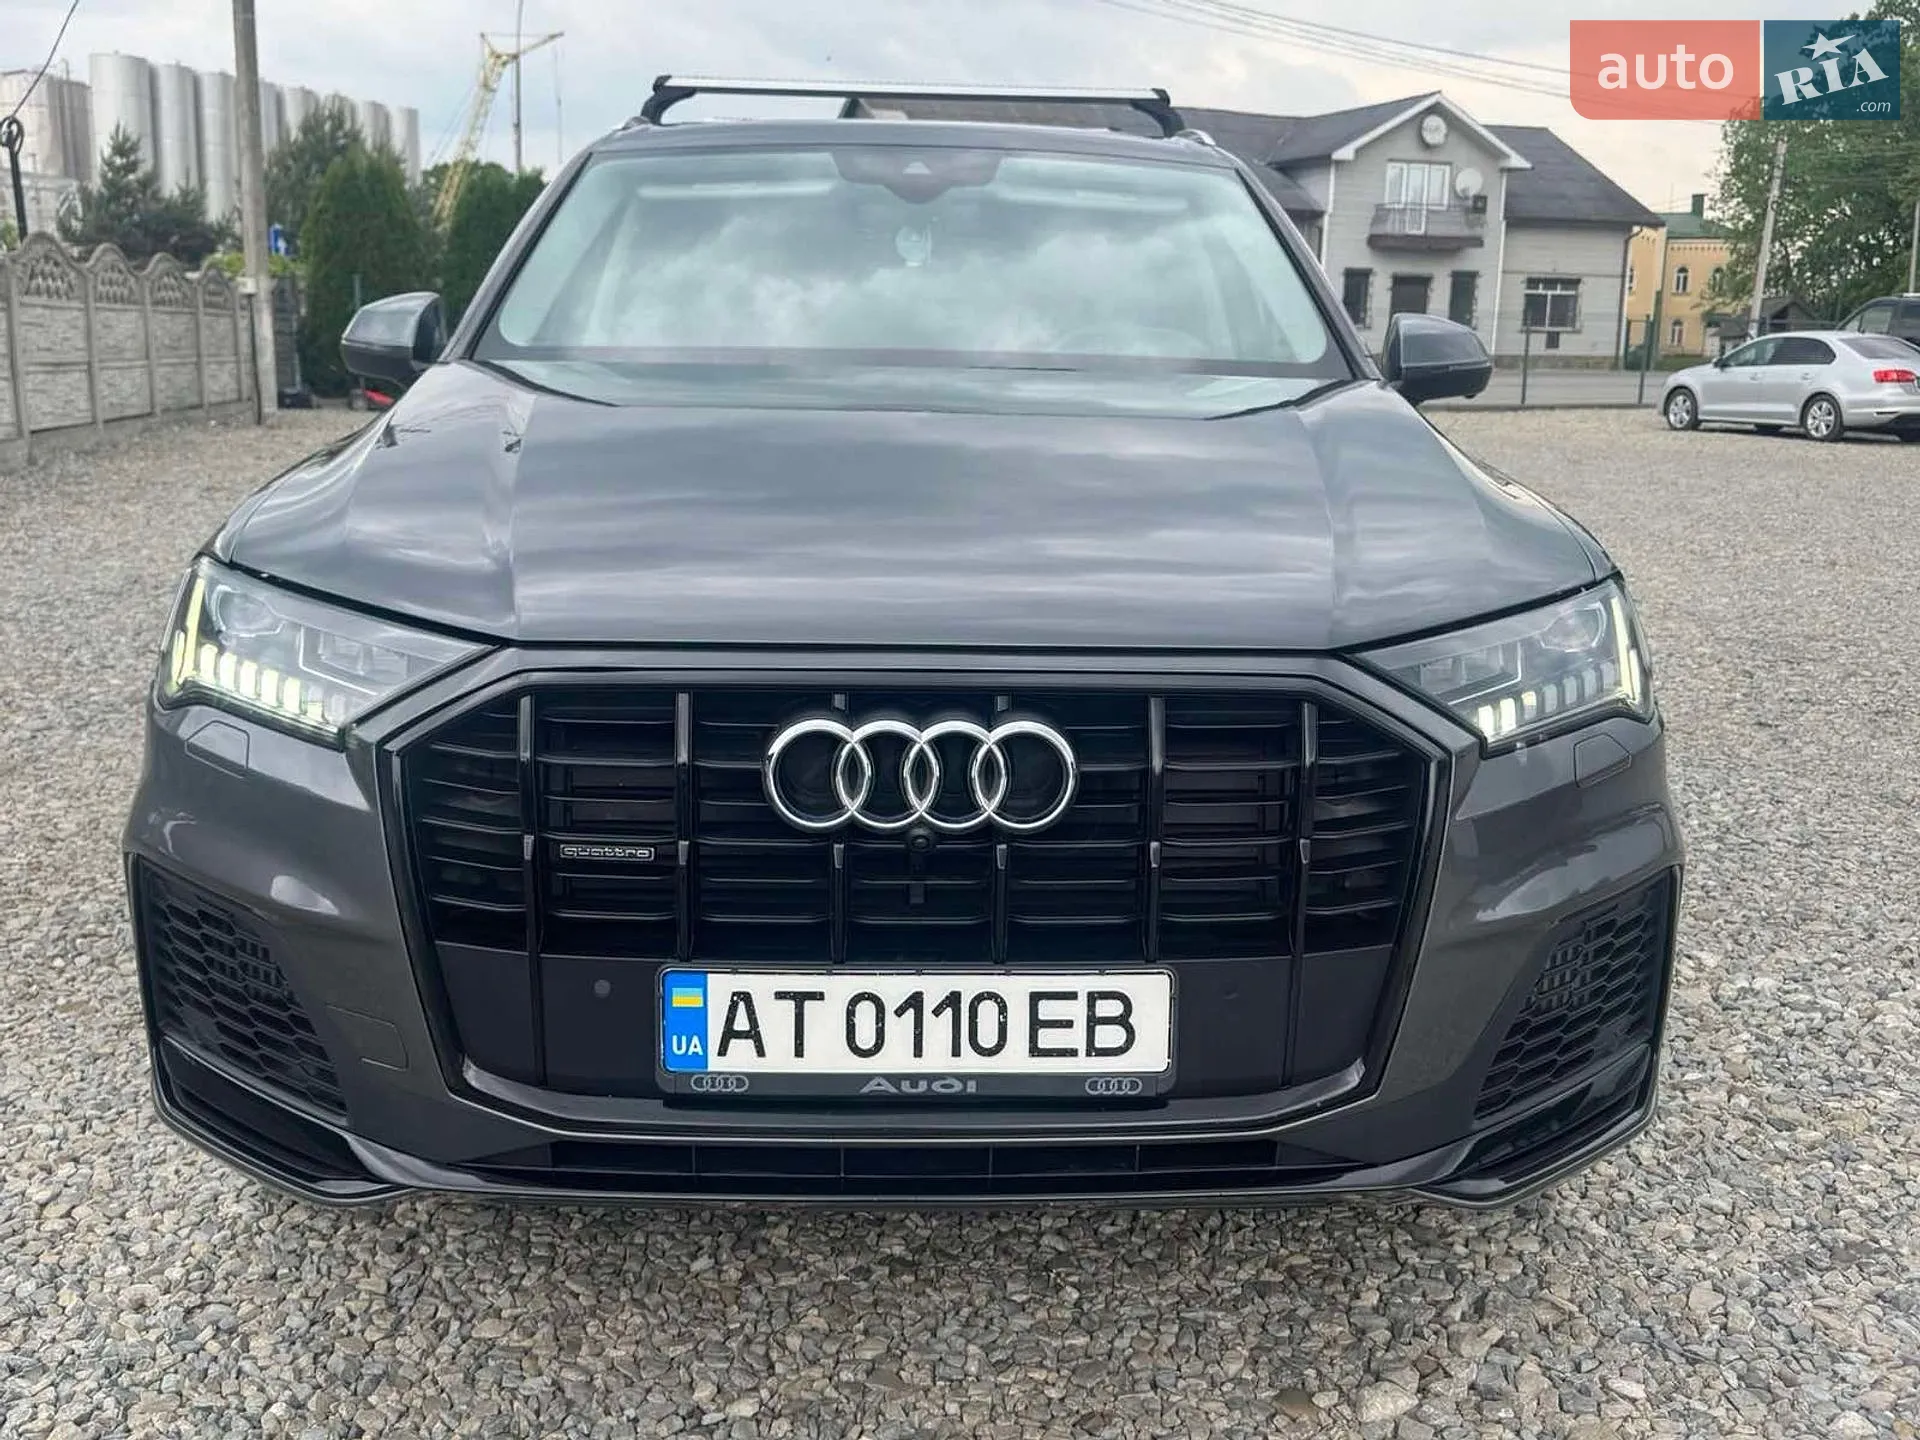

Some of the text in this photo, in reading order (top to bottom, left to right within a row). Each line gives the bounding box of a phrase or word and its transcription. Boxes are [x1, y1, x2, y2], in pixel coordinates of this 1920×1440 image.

[562, 847, 651, 858] quattro
[716, 991, 1136, 1058] AT 0110 EB
[672, 1035, 704, 1056] UA
[859, 1075, 978, 1094] Audi
